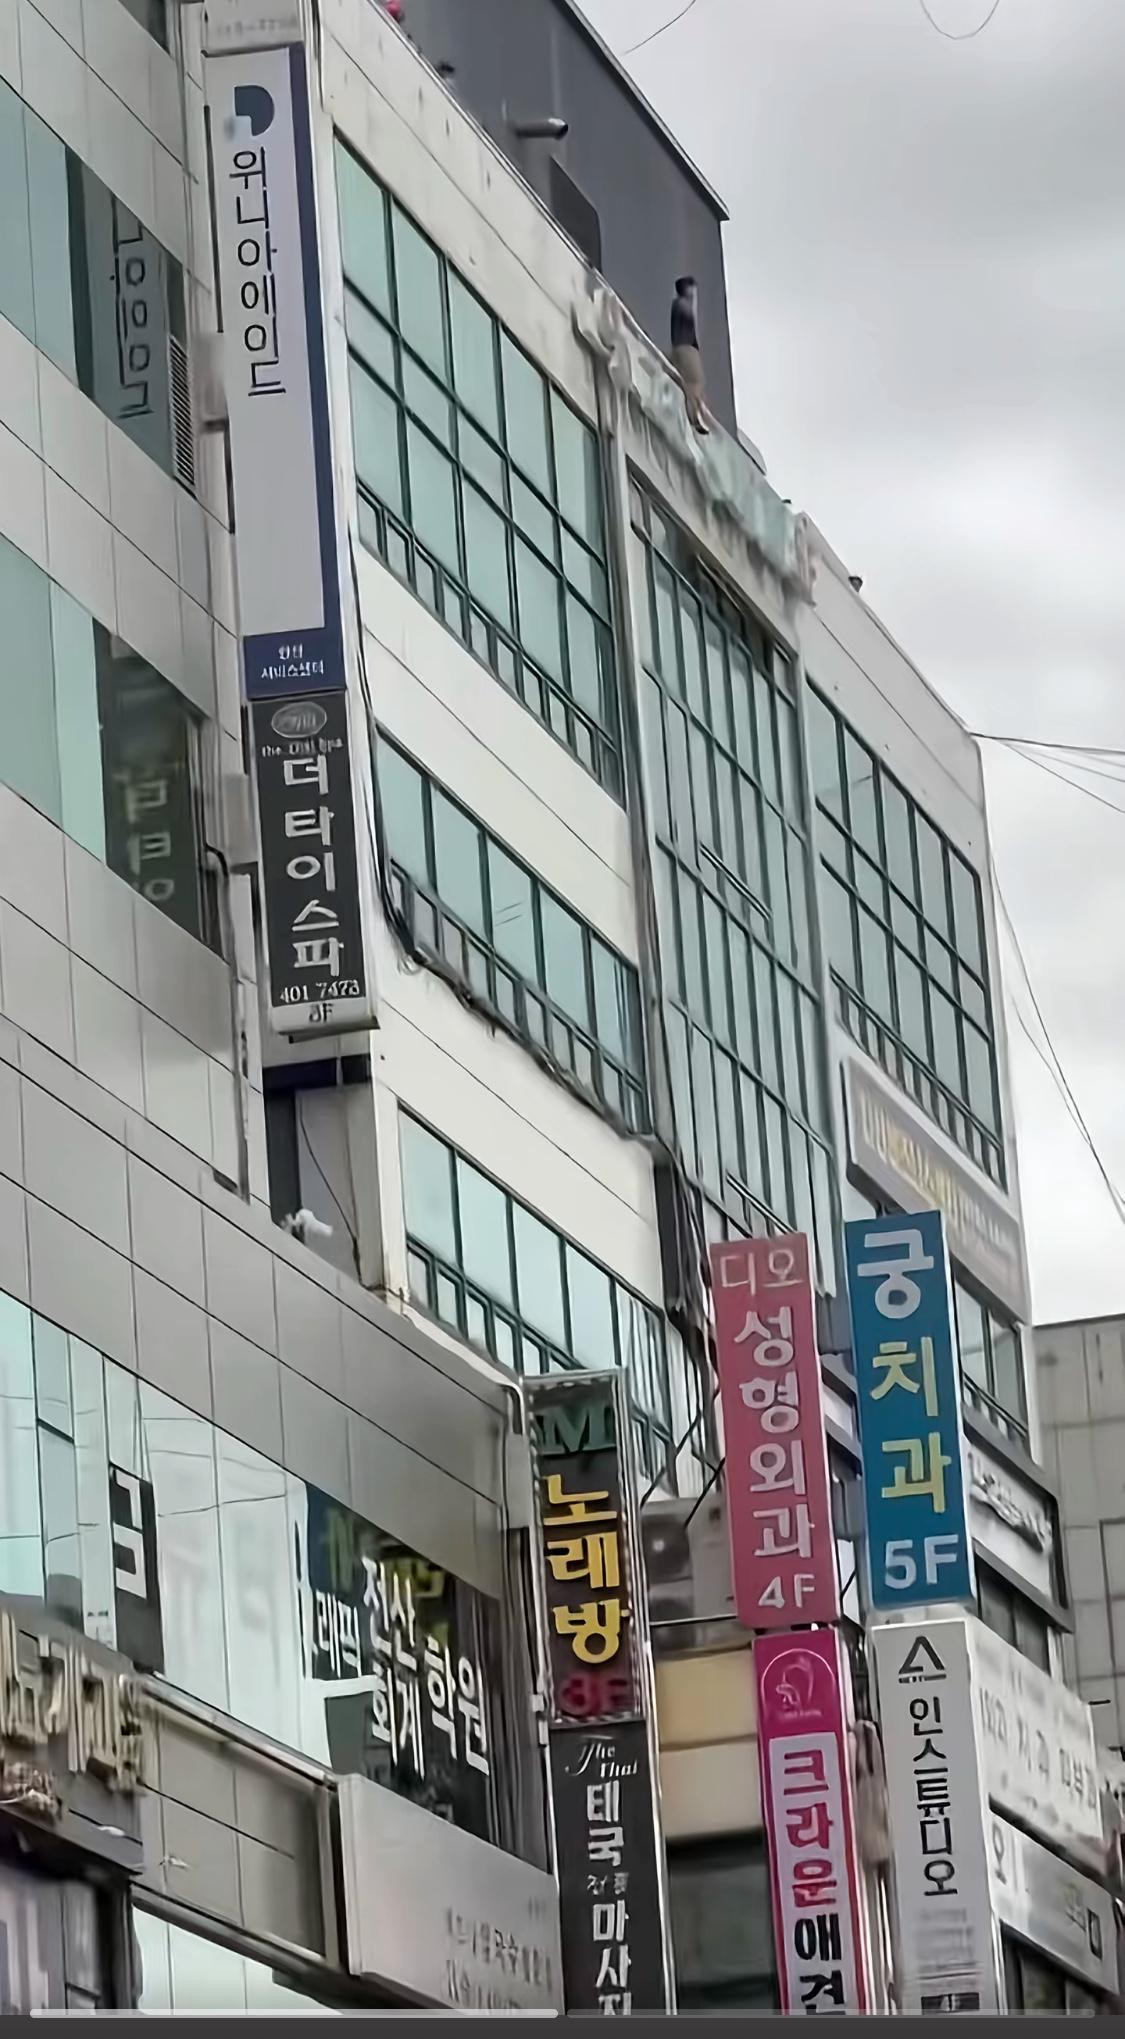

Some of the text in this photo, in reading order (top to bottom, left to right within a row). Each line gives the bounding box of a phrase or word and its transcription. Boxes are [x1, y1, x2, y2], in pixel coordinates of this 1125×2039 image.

[228, 146, 286, 396] 위니아에이드
[719, 1248, 805, 1297] 디오
[733, 1306, 816, 1560] 성형외과
[361, 1556, 417, 1672] 전산
[543, 1473, 630, 1664] 노래방
[758, 1573, 816, 1610] 4F
[884, 1532, 960, 1591] 5F
[372, 1661, 425, 1782] 회계
[424, 1634, 491, 1776] 학원
[587, 1780, 625, 1867] 태국
[908, 1696, 959, 1896] 인스튜디오
